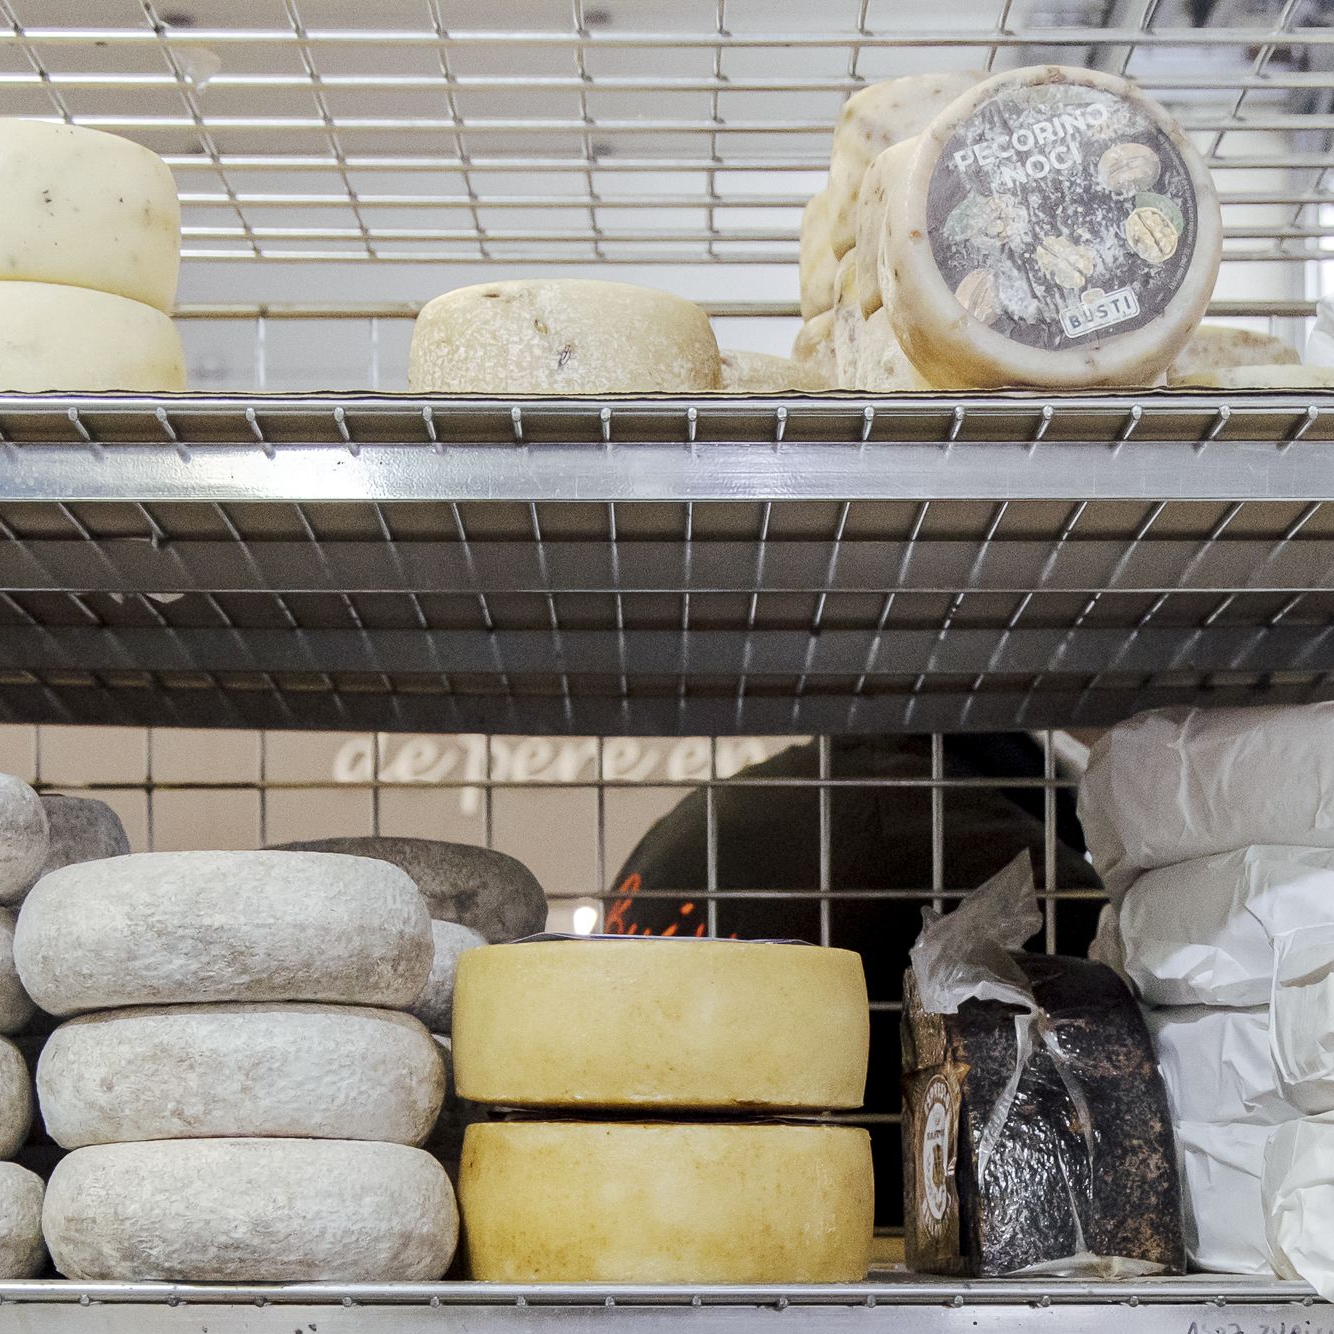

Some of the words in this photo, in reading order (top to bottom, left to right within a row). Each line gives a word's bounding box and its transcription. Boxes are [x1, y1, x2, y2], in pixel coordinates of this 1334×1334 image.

[953, 103, 1108, 172] PECORINO
[1000, 143, 1083, 188] NOCI
[1067, 295, 1133, 330] BUSTI
